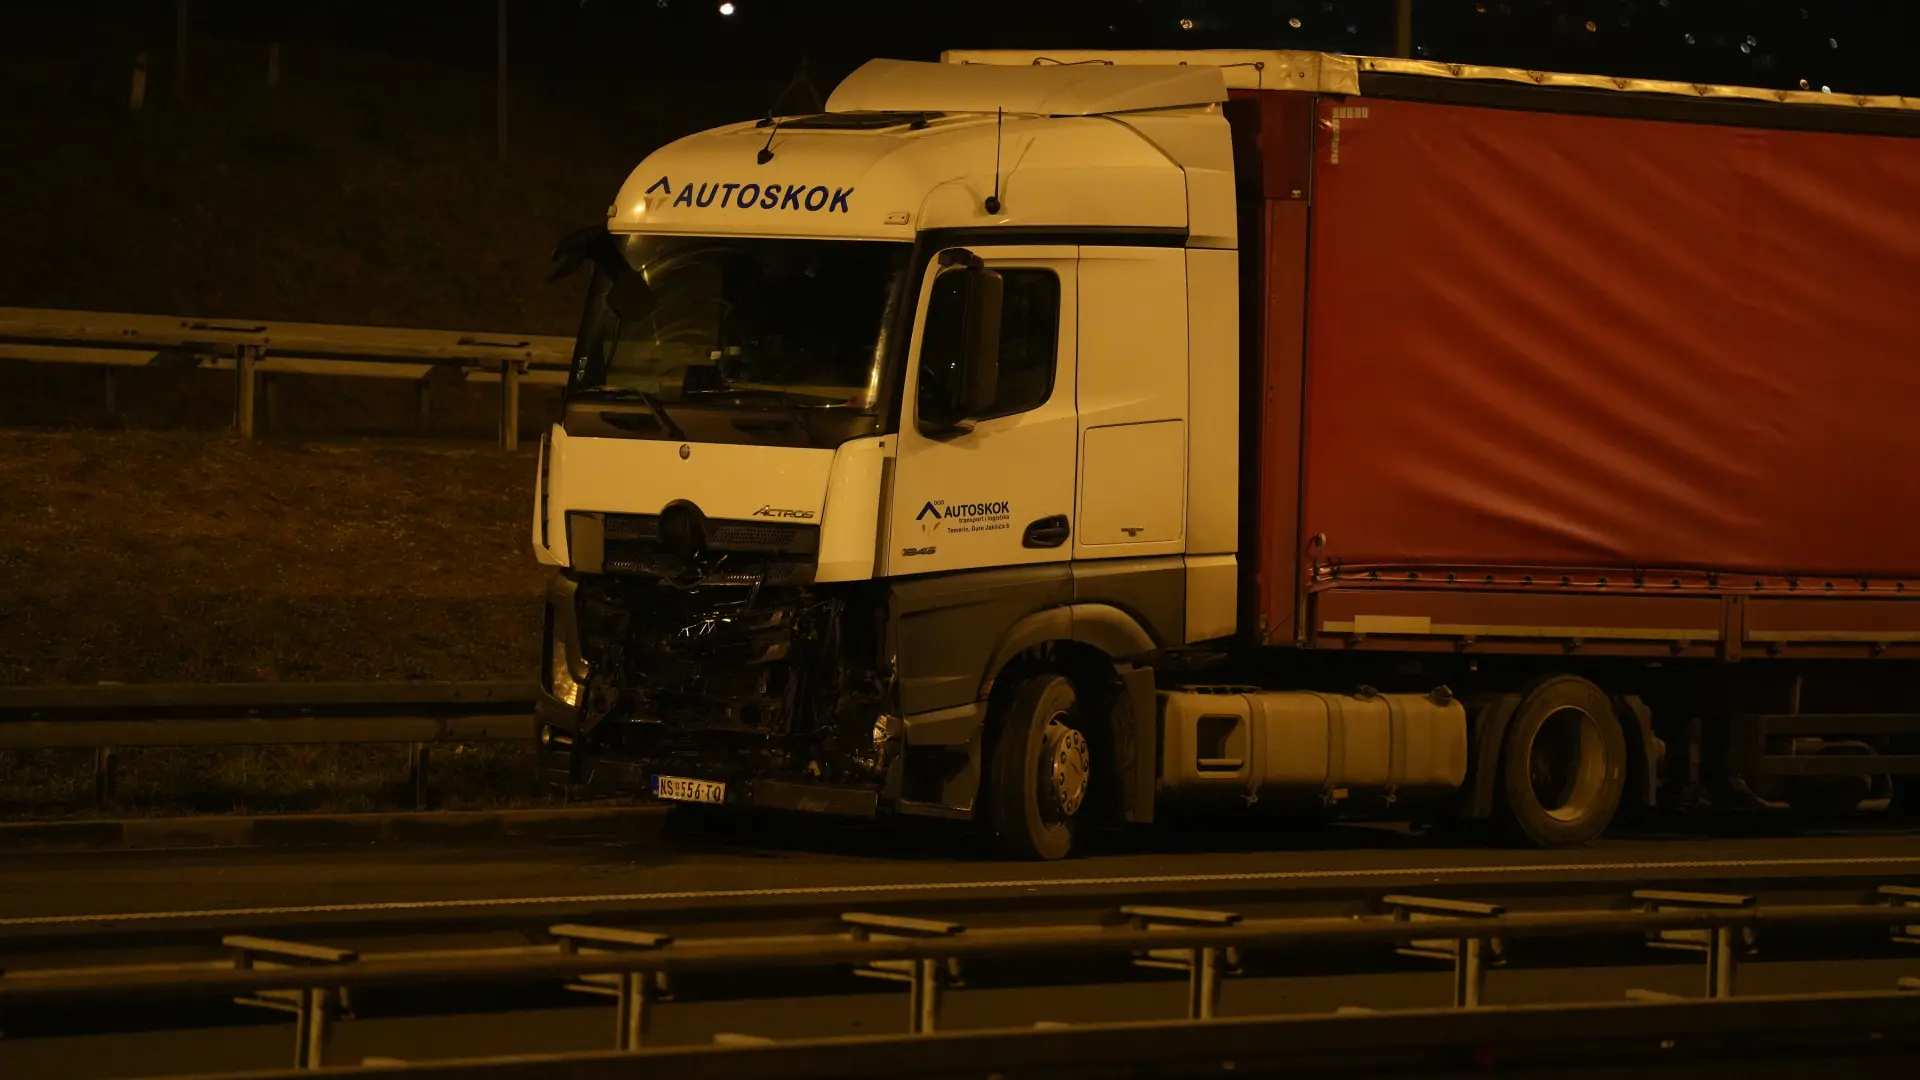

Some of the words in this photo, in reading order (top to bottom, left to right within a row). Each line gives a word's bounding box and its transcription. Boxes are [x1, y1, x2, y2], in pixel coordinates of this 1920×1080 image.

[673, 182, 854, 213] AUTOSKOK
[752, 505, 814, 518] ACTROS
[944, 501, 1009, 518] AUTOSKOK
[988, 514, 1009, 522] logistika
[660, 779, 674, 796] NS
